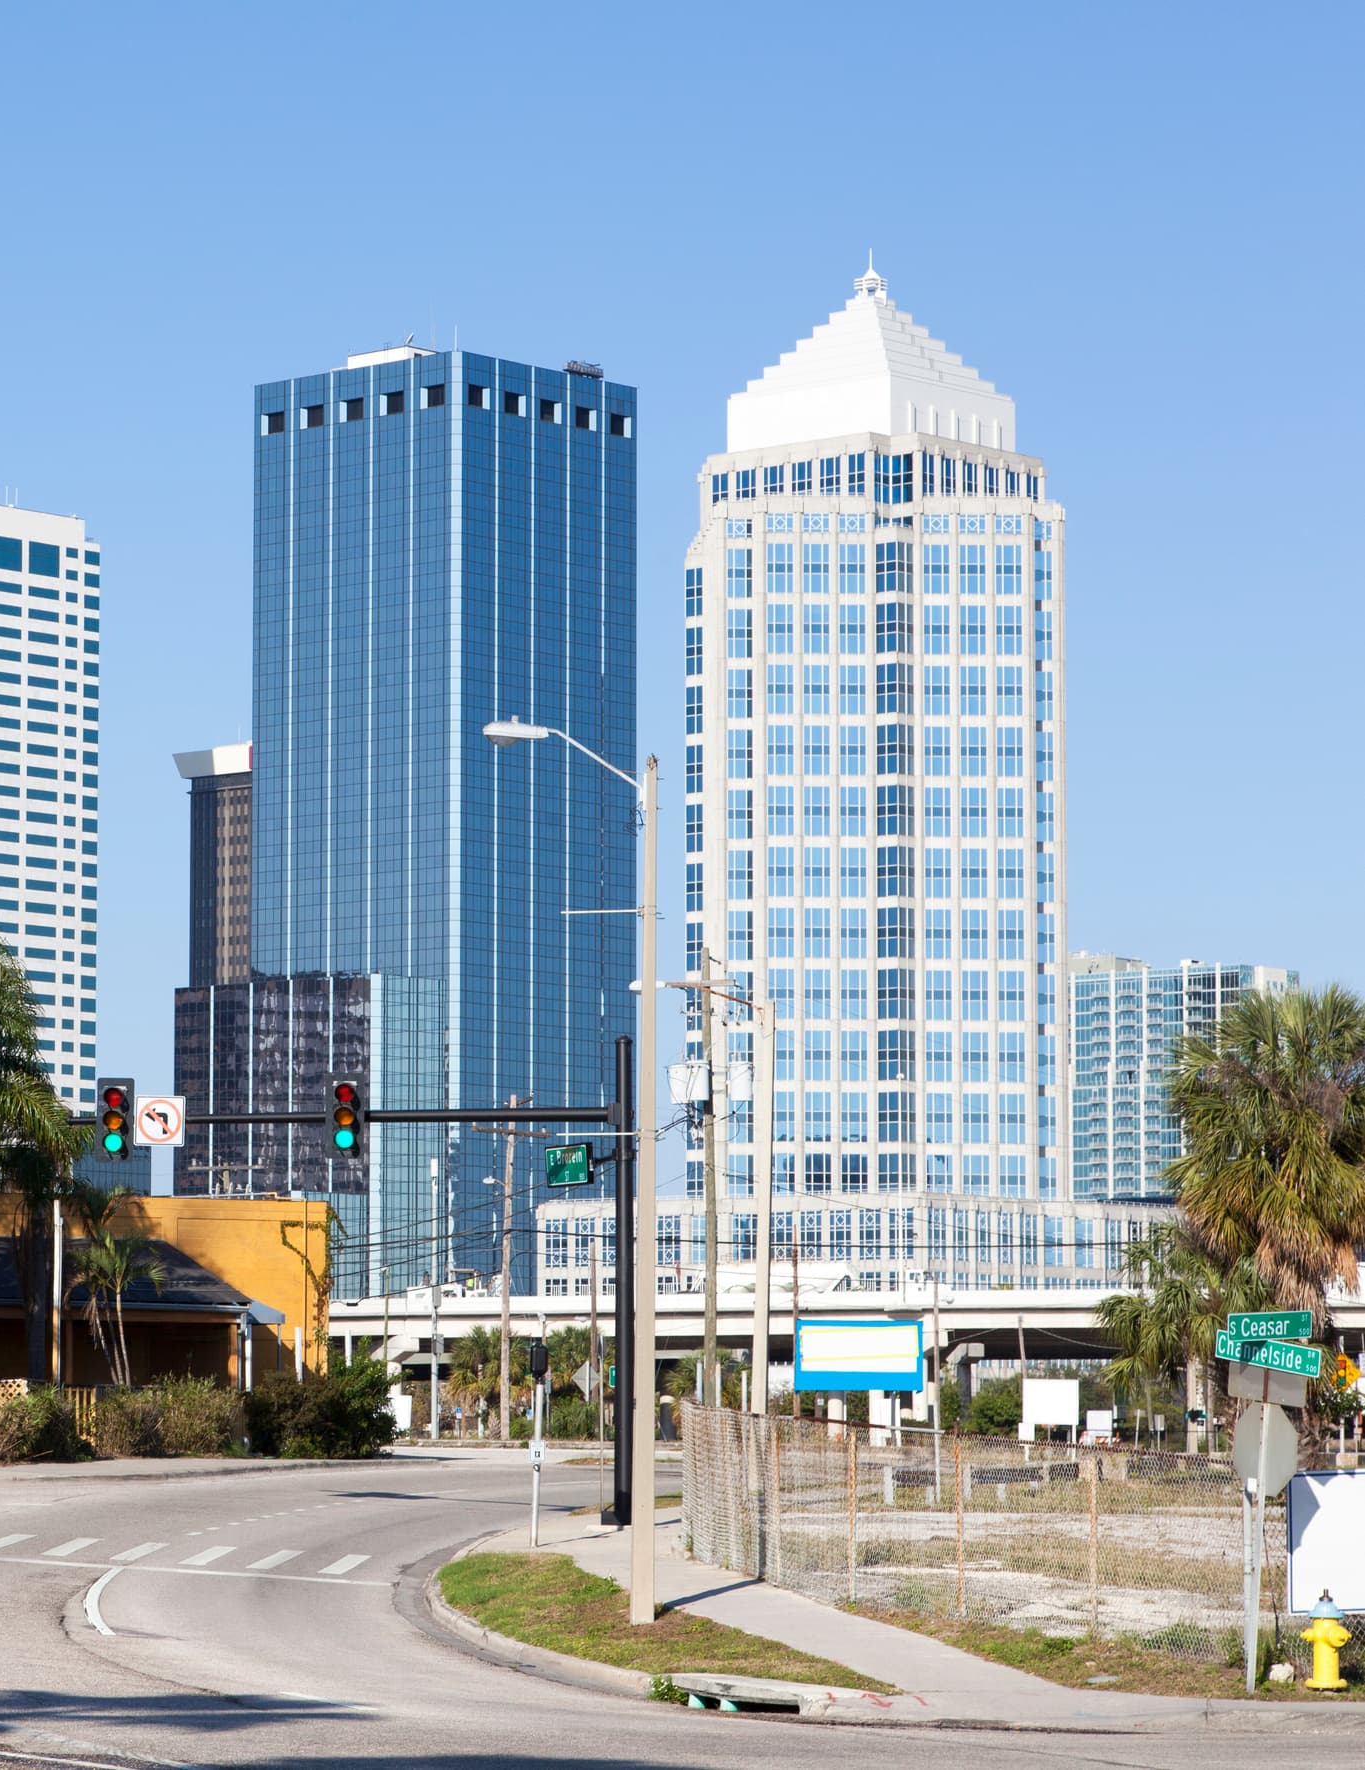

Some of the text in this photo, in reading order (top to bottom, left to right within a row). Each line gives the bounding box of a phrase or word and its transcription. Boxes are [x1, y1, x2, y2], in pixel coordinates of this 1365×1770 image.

[549, 1154, 554, 1166] E
[1241, 1317, 1290, 1337] Ceasar
[1298, 1327, 1310, 1336] 500
[1218, 1334, 1303, 1370] Channelside
[1307, 1350, 1316, 1359] DR
[1305, 1364, 1317, 1374] 500
